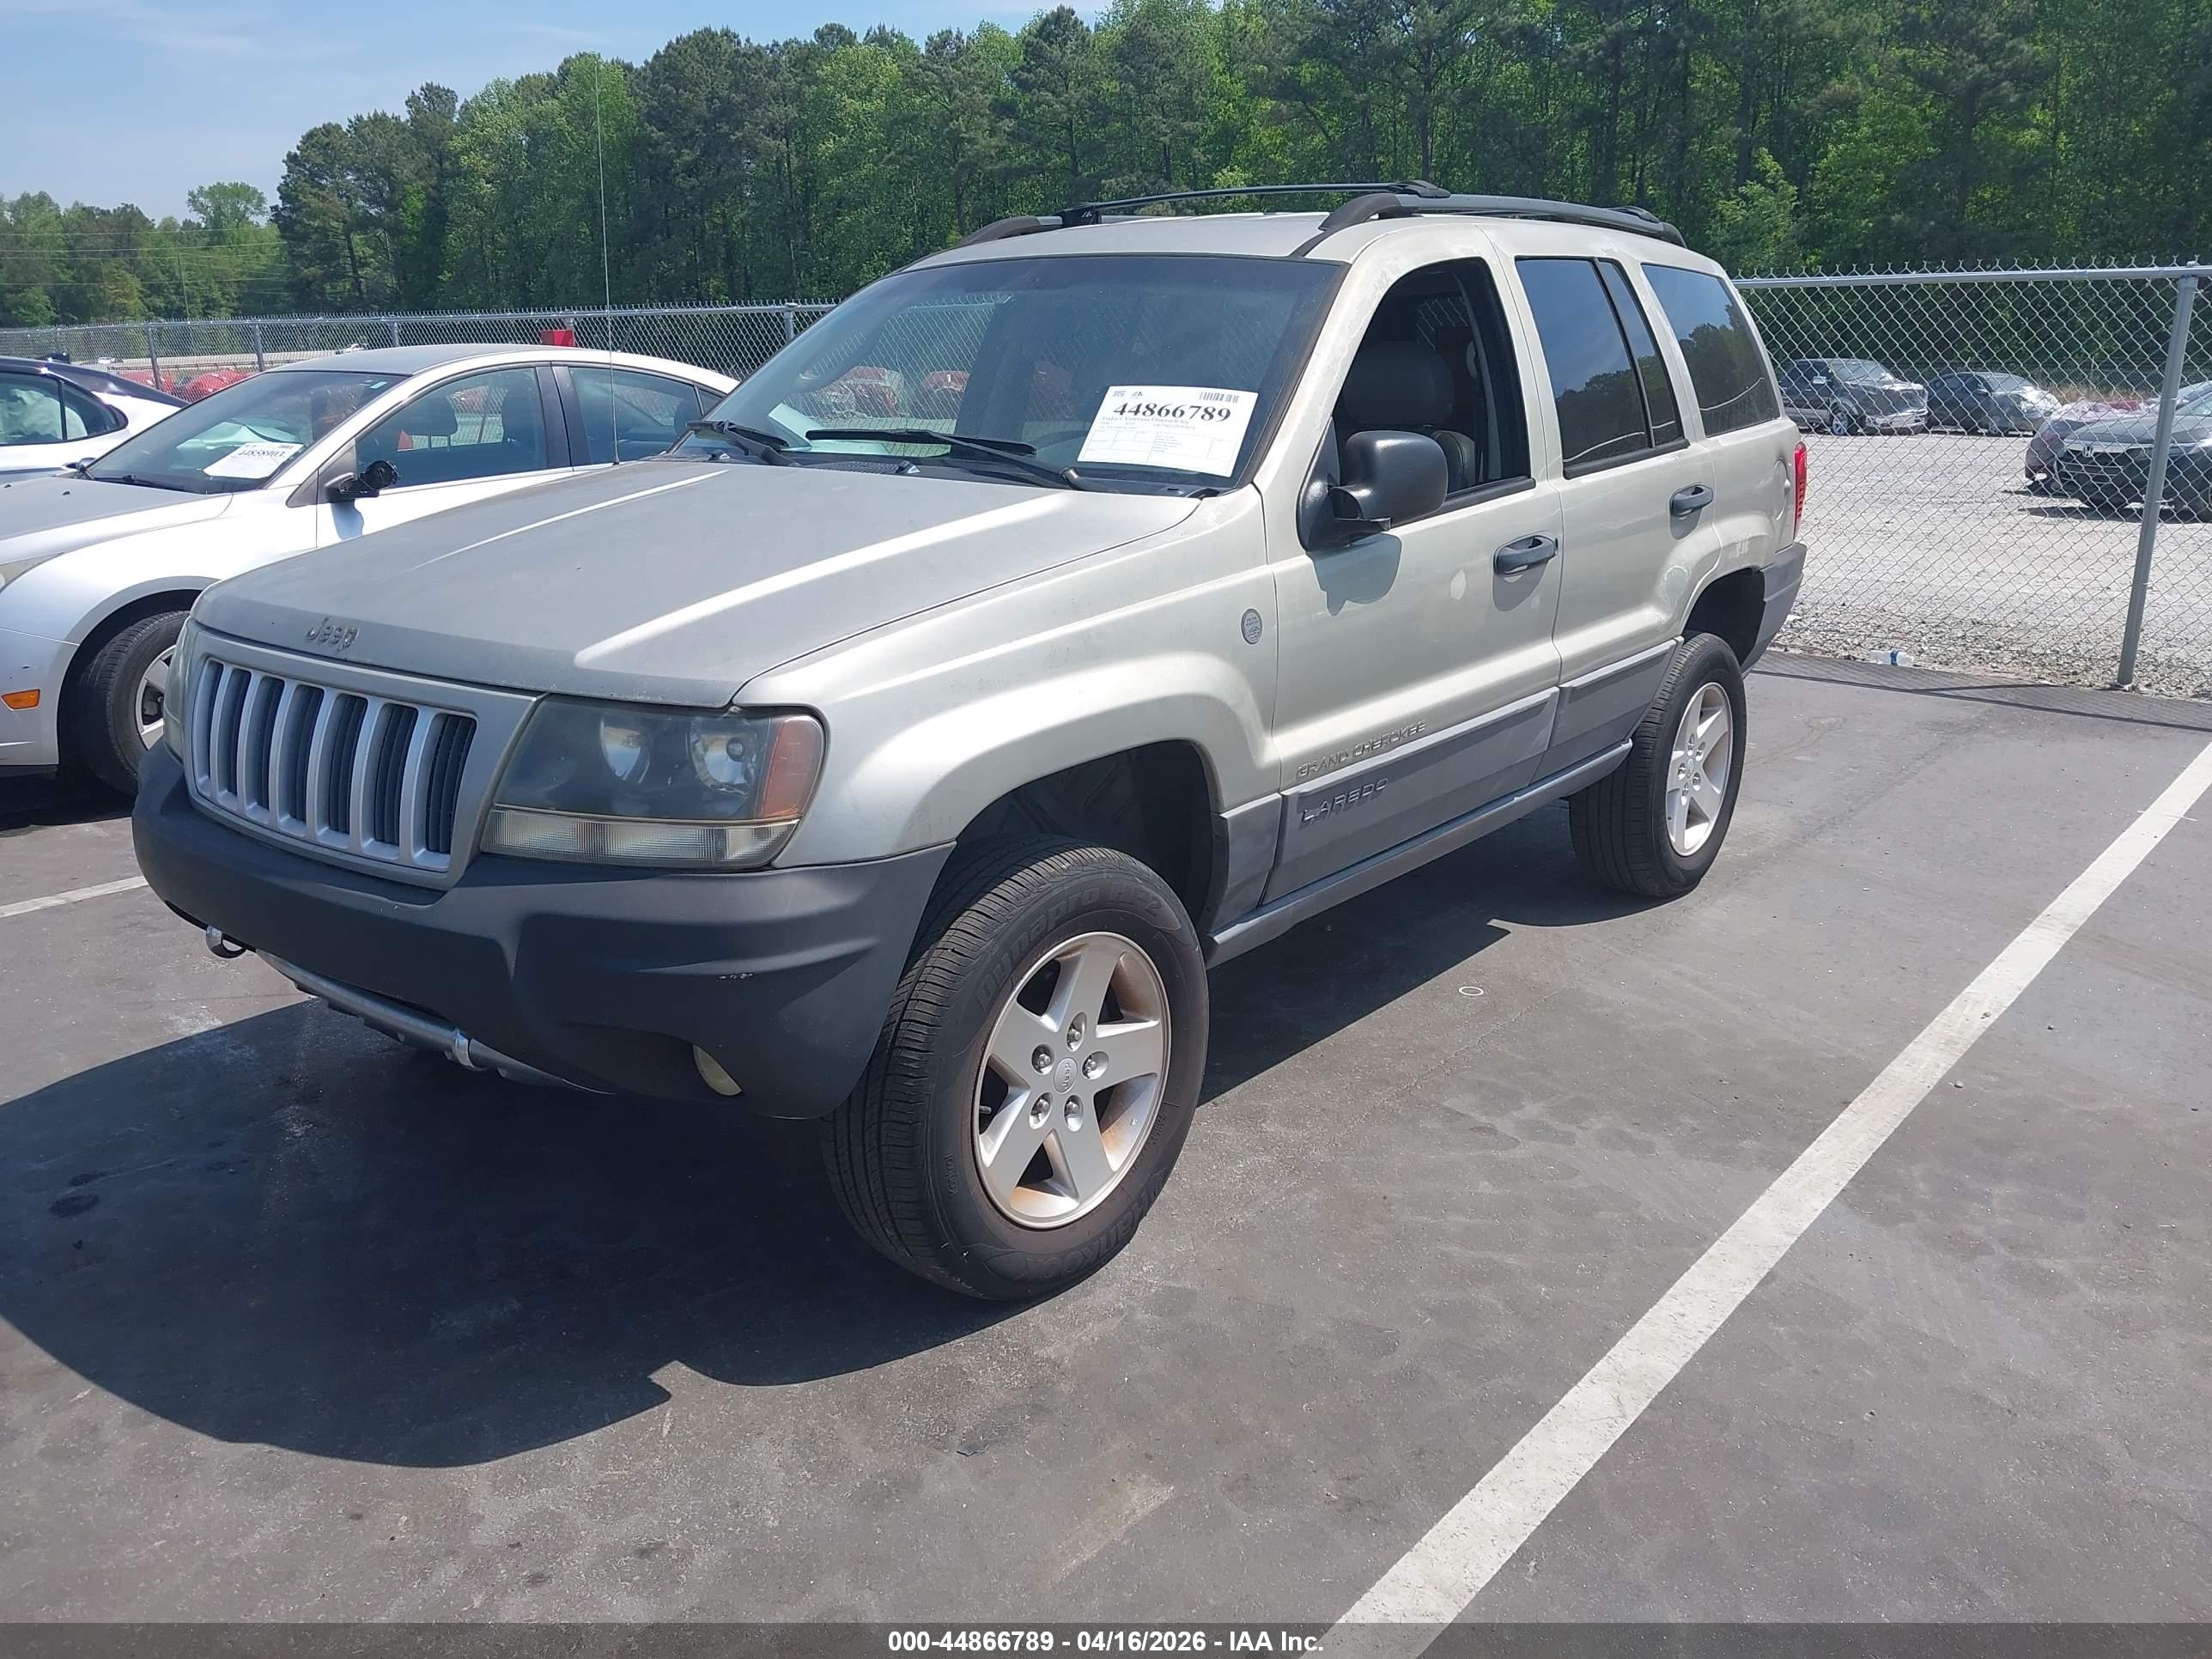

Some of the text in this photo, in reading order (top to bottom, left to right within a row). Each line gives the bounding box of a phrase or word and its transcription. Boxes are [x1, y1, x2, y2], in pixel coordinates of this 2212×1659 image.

[1114, 401, 1231, 422] 44866789
[306, 616, 360, 653] Jeep
[1297, 720, 1428, 778] GRAND CHEROKEE
[1302, 777, 1389, 822] LAREDO
